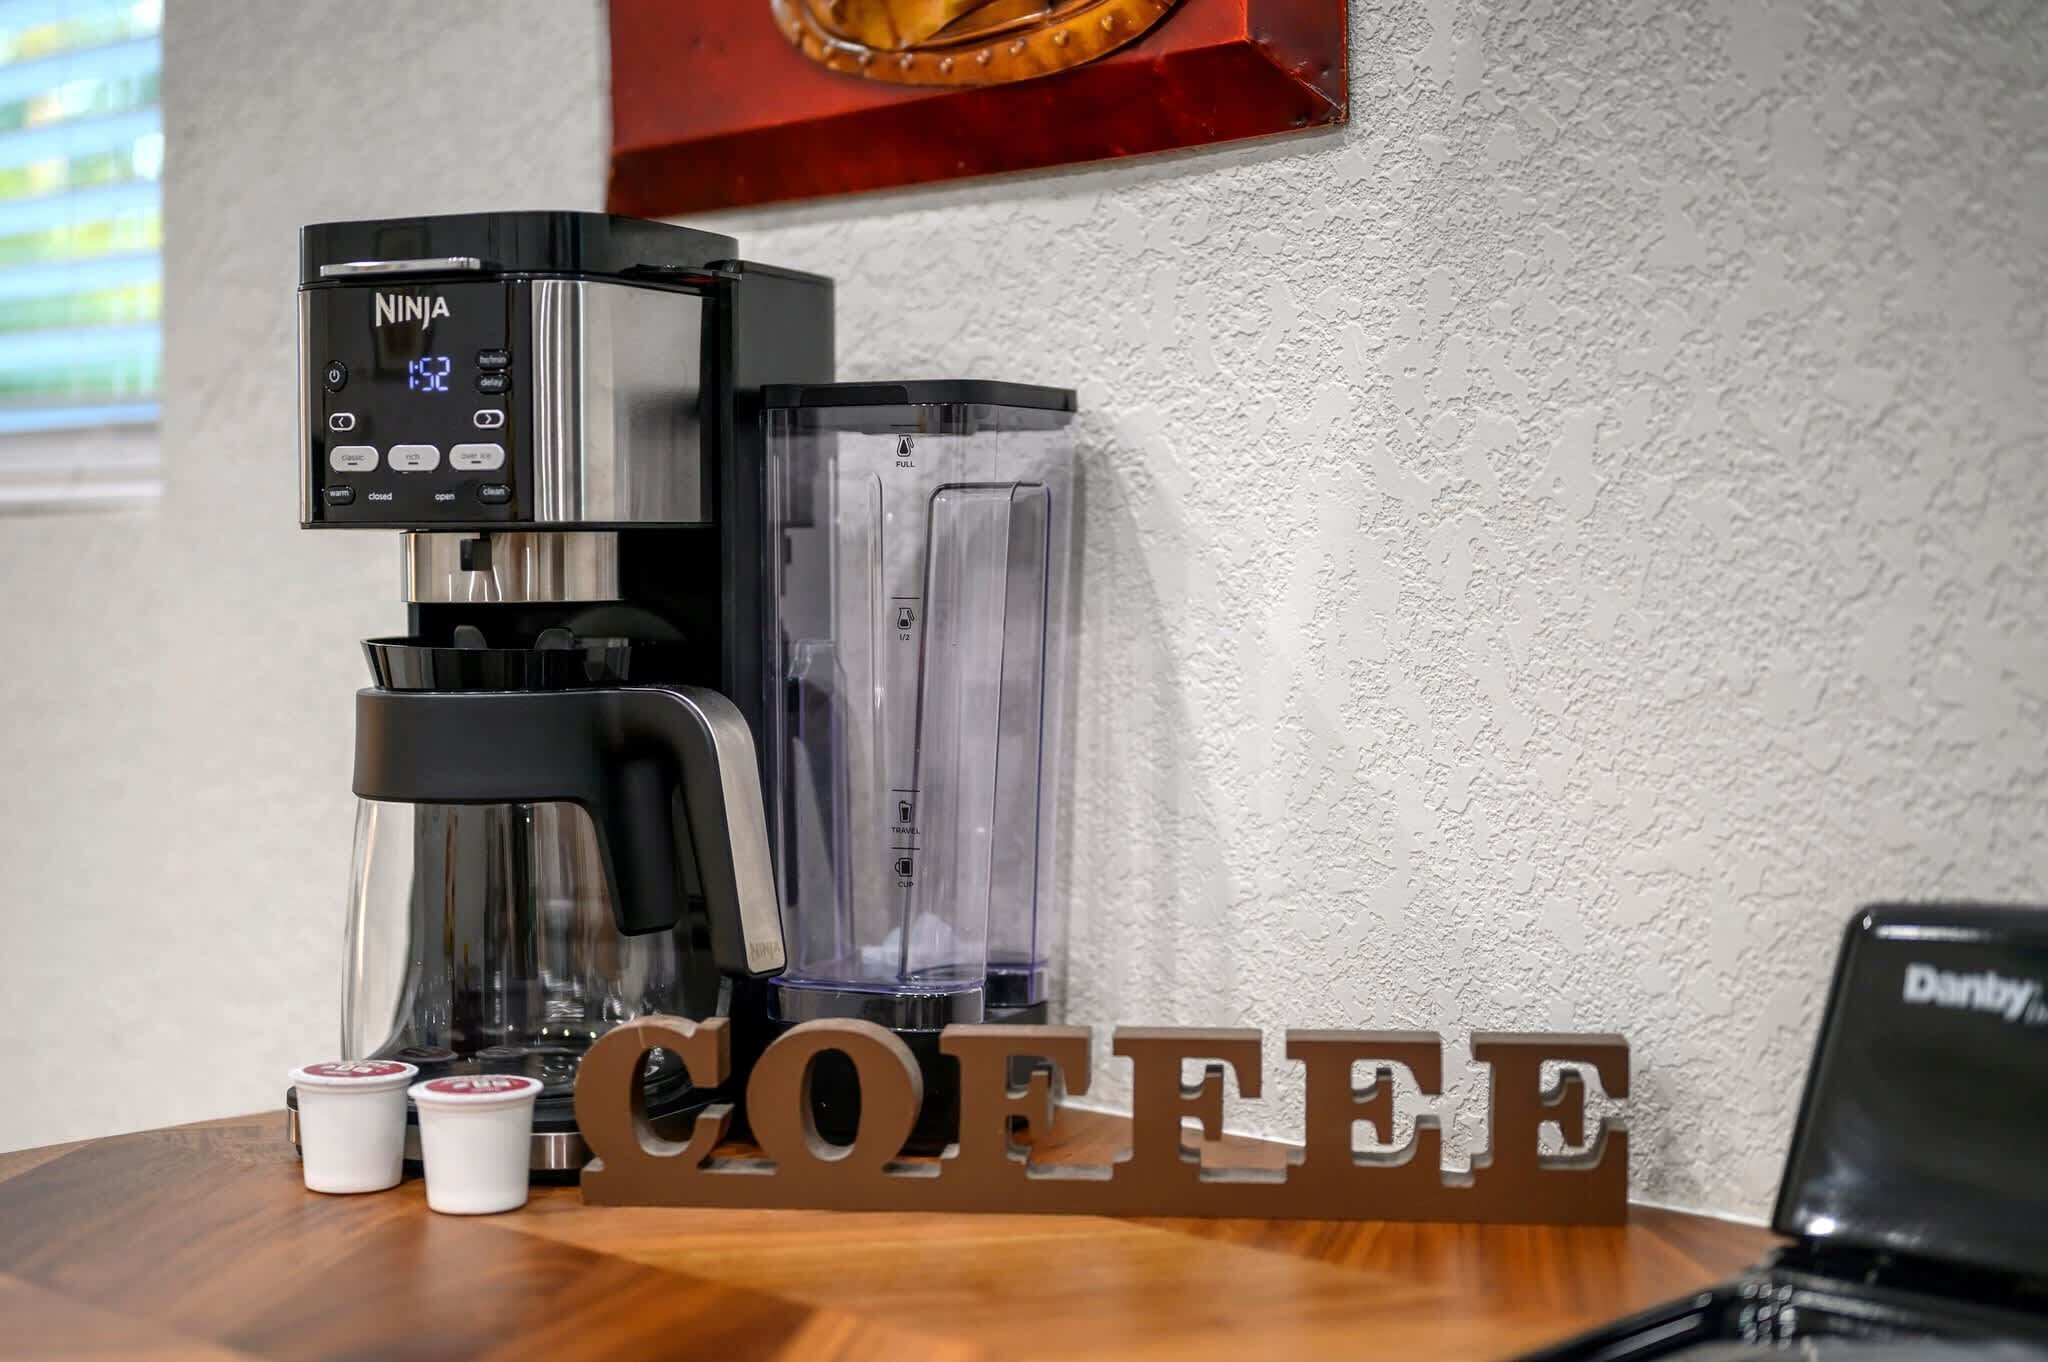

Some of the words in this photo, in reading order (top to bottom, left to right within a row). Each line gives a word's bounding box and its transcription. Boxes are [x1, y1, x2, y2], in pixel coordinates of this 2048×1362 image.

[375, 292, 450, 330] NINJA
[409, 356, 450, 391] 1:52
[368, 492, 393, 501] closed
[434, 493, 456, 502] open
[483, 487, 505, 496] clean
[892, 826, 920, 835] TRAVEL
[1902, 963, 2033, 1022] Danby
[575, 1016, 1630, 1210] COFFEE
